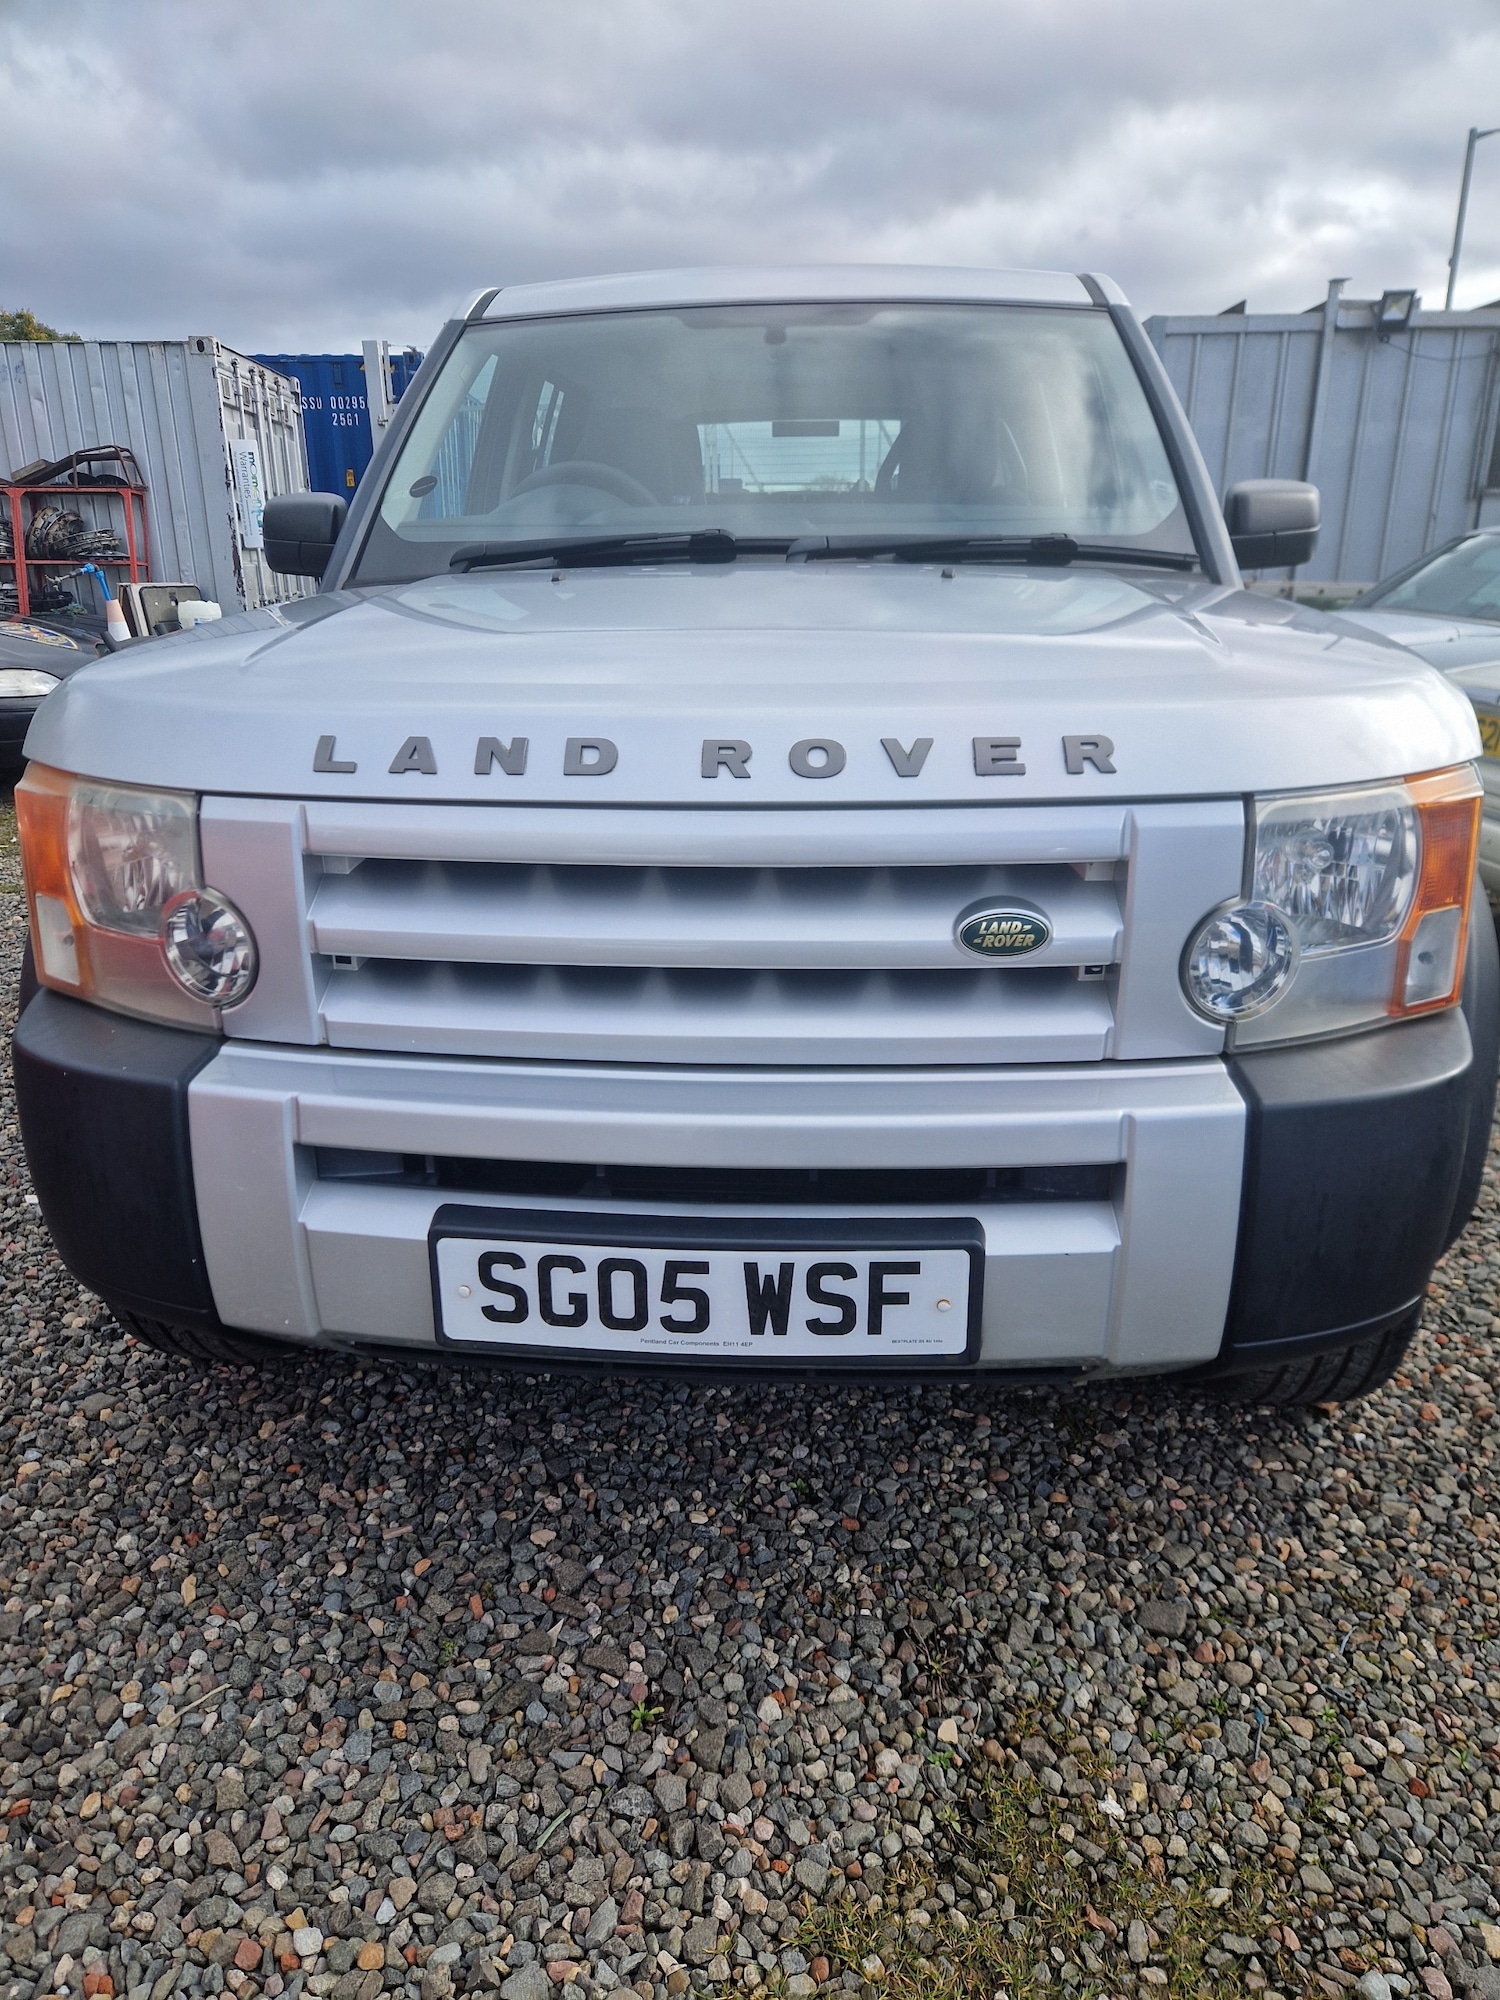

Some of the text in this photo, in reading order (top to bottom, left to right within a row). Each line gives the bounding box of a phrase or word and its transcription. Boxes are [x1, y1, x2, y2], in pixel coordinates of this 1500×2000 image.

[332, 412, 359, 426] 25G1
[239, 451, 251, 499] Warranties
[312, 734, 1117, 779] LAND ROVER
[478, 1251, 921, 1336] SG05 WSF
